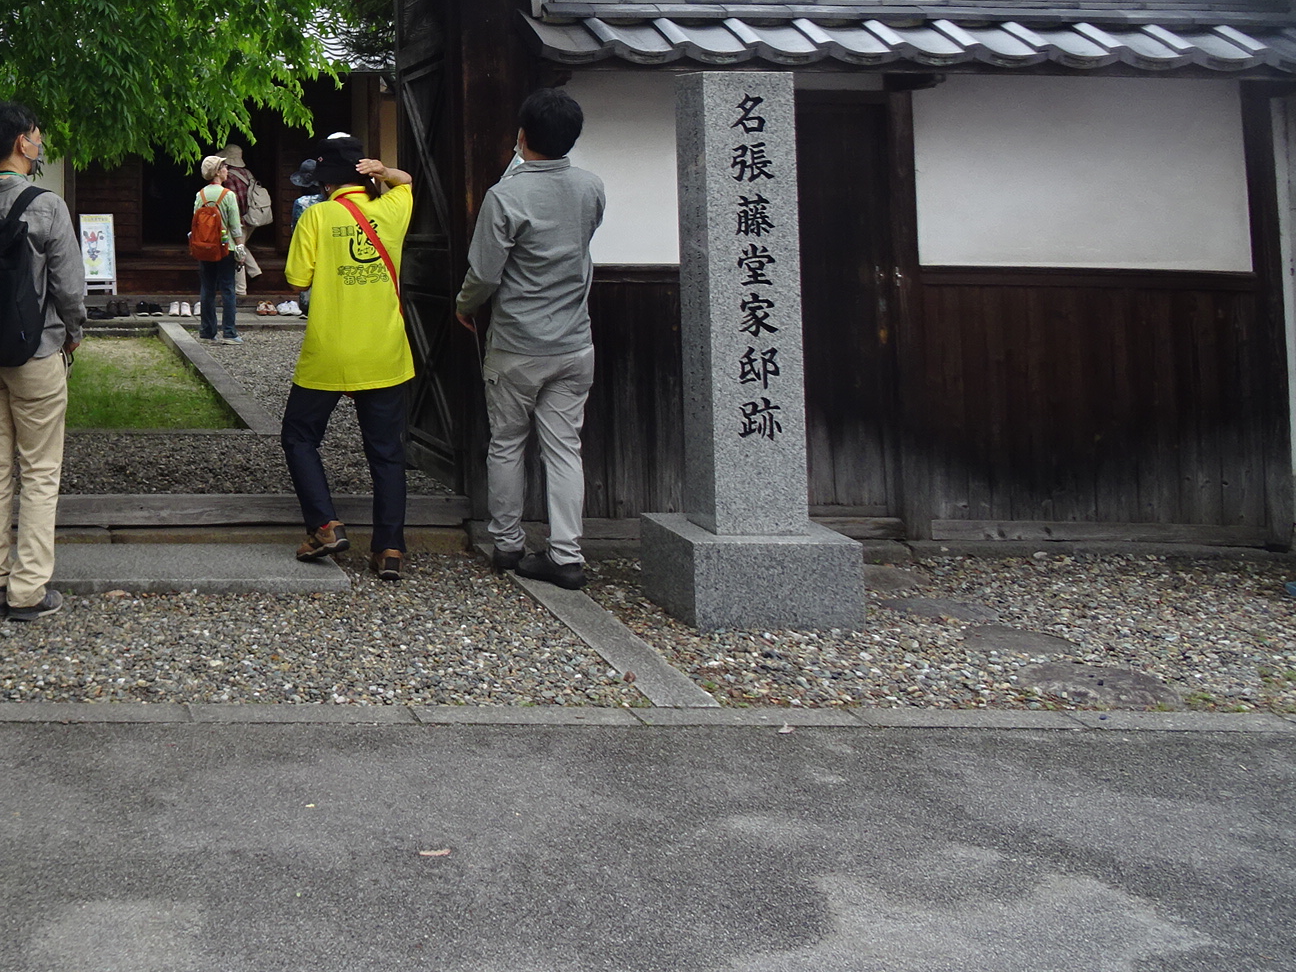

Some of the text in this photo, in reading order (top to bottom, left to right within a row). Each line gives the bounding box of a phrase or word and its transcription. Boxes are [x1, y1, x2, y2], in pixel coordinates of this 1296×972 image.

[332, 225, 356, 237] 三重県
[730, 92, 783, 442] 名張藤堂家邸跡
